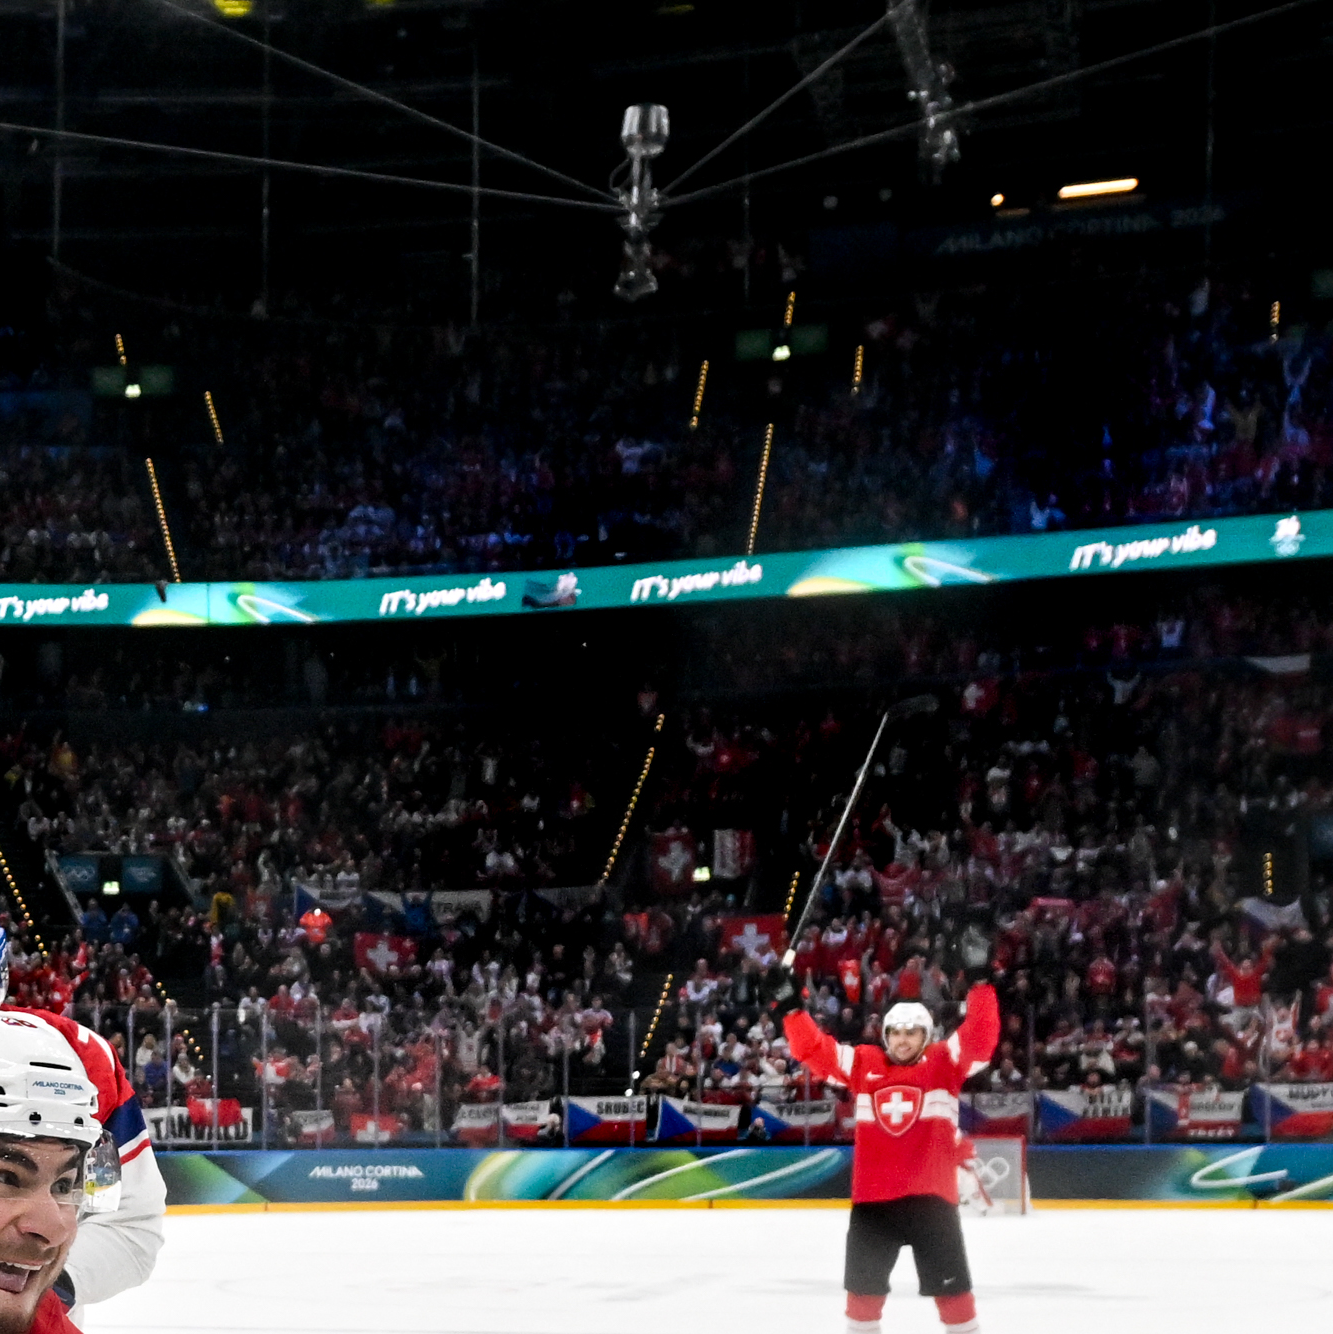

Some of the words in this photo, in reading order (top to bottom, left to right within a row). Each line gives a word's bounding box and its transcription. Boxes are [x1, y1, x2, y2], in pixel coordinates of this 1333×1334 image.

[1111, 537, 1171, 569] your
[1171, 524, 1217, 554] vibe
[415, 587, 466, 616] your
[466, 577, 506, 603] vibe
[668, 571, 720, 600] your
[720, 560, 763, 586] vibe
[23, 597, 70, 622] your
[71, 588, 109, 612] vibe
[31, 1081, 59, 1089] MILANO
[309, 1166, 363, 1178] MILANO
[365, 1166, 424, 1178] CORTINA
[351, 1178, 379, 1190] 2026
